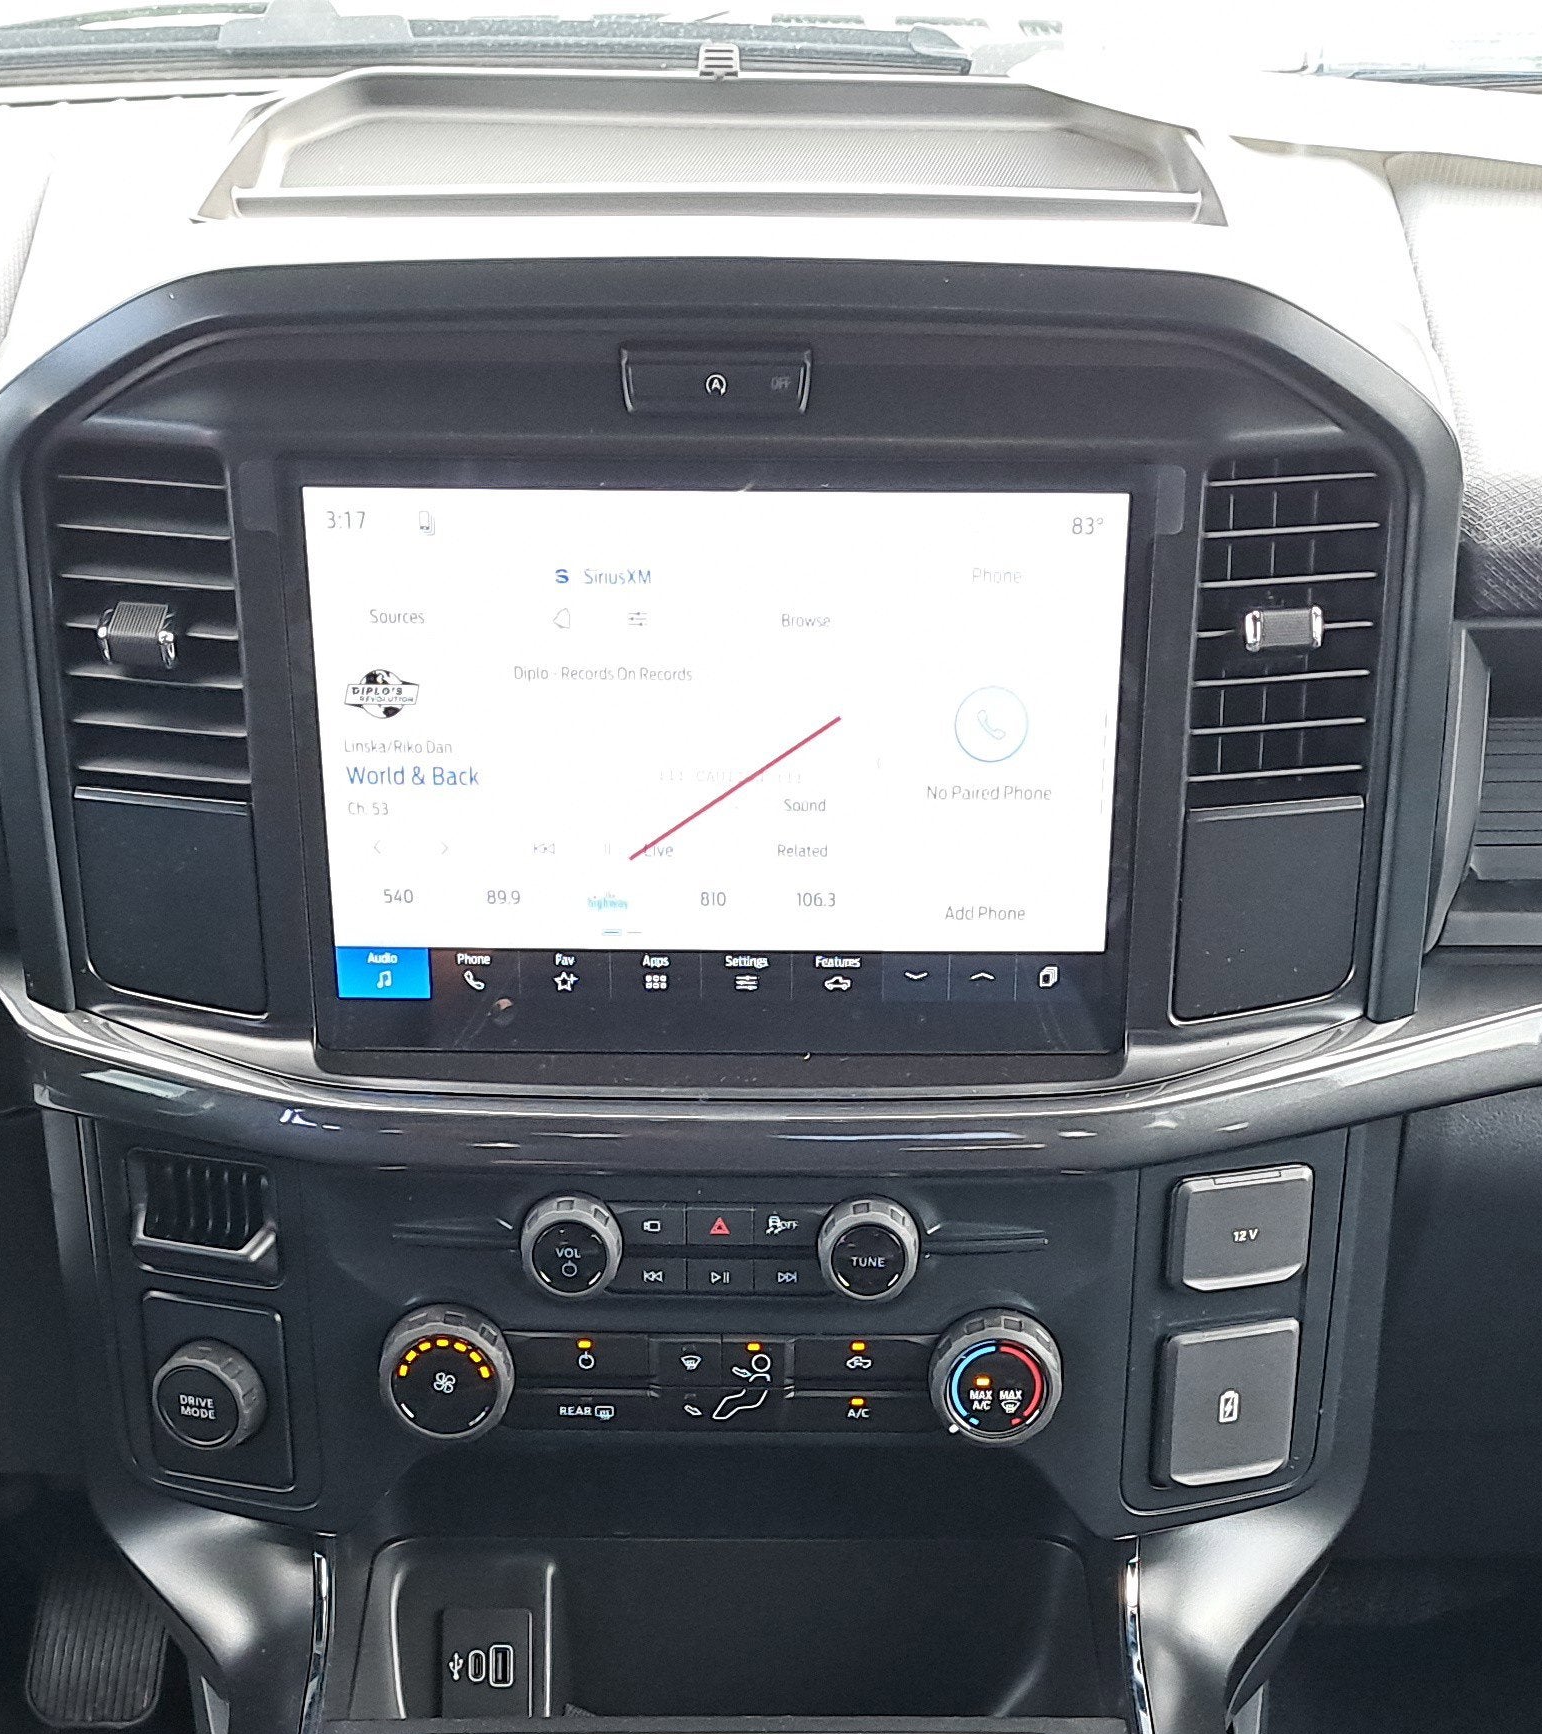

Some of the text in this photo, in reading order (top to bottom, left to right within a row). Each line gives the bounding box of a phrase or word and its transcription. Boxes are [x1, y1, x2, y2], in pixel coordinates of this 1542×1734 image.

[326, 510, 366, 529] 3:17
[1071, 517, 1104, 535] 83°
[584, 568, 652, 585] SiriusXM
[971, 567, 1023, 584] Phone
[369, 608, 426, 625] Sources
[780, 613, 832, 628] Browse
[514, 666, 549, 682] Diplo
[561, 666, 614, 681] Records
[617, 667, 636, 681] On
[639, 667, 693, 681] Records
[352, 686, 403, 696] DIPLO'S
[426, 740, 453, 754] Dan
[346, 765, 480, 786] World & Back
[926, 785, 1053, 801] No Paired Phone
[372, 801, 389, 816] 53
[784, 799, 827, 813] Sound
[777, 844, 829, 858] Related
[383, 889, 415, 904] 540
[486, 890, 521, 905] 89.9
[700, 891, 727, 907] 810
[796, 892, 836, 908] 106.3
[945, 906, 1026, 921] Add Phone
[366, 952, 398, 965] Audio
[456, 953, 491, 966] Phone
[555, 954, 576, 967] Fav
[642, 954, 670, 968] Apps
[724, 955, 769, 969] Settings
[814, 956, 861, 968] Features
[1233, 1228, 1259, 1243] 12 V
[555, 1247, 581, 1259] VOL
[850, 1256, 886, 1268] TUNE
[179, 1394, 215, 1409] DRIVE
[969, 1389, 993, 1400] MAX
[999, 1389, 1023, 1400] MAX
[559, 1405, 592, 1417] REAR
[972, 1400, 991, 1411] A/C
[180, 1406, 217, 1420] MODE
[847, 1407, 871, 1420] A/C
